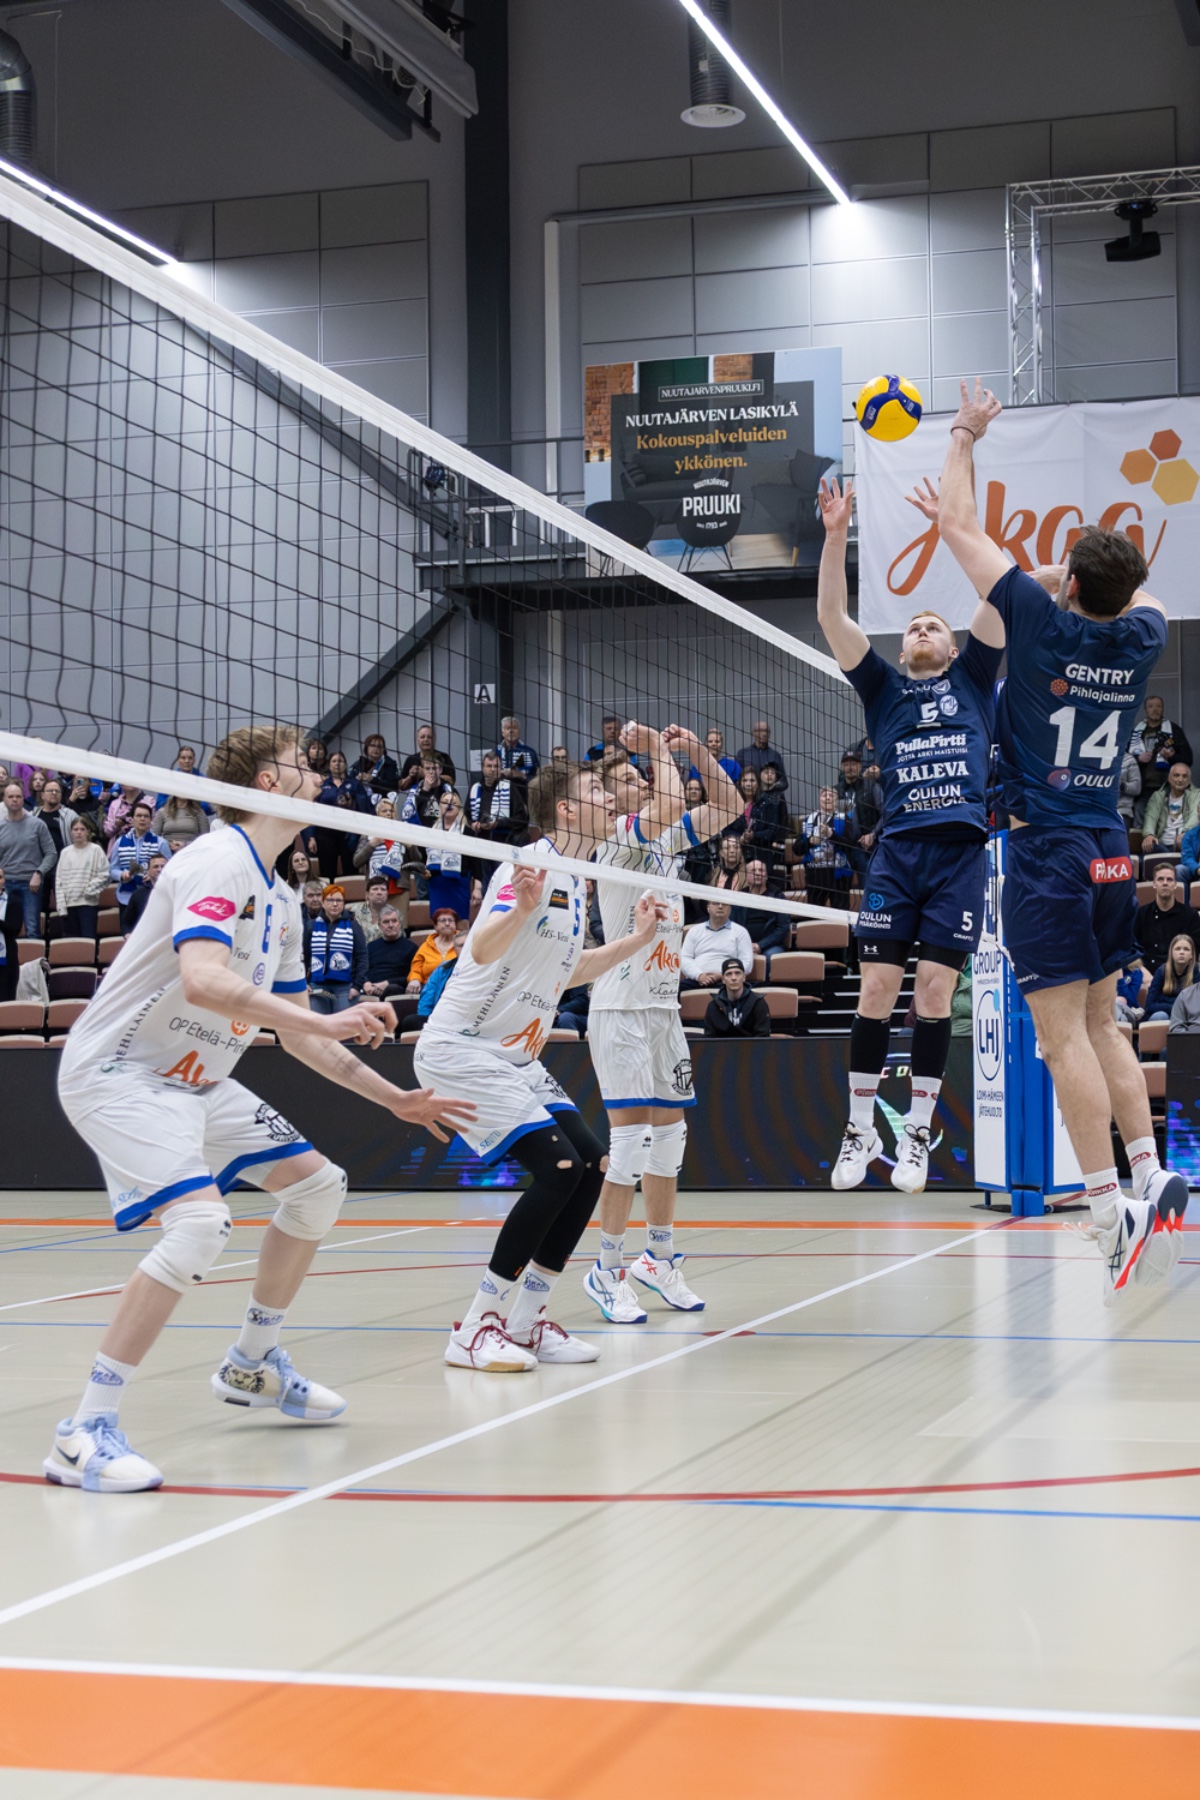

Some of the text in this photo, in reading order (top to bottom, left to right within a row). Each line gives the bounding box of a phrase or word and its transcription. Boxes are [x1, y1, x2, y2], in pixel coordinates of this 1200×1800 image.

[625, 401, 799, 428] NUUTAJÄRVEN LASIKYLÄ
[636, 426, 788, 450] Kokouspalveluiden
[675, 454, 748, 474] ykkönen.
[683, 494, 740, 517] PRUUKI
[1065, 663, 1134, 685] GENTRY
[477, 685, 491, 702] A
[1069, 685, 1136, 703] Pihlajalinna
[919, 702, 939, 723] 5
[896, 734, 966, 755] PullaPirtti
[1050, 706, 1122, 770] 14
[897, 761, 969, 783] KALEVA
[1074, 773, 1115, 788] OULU
[908, 785, 961, 801] OULUN
[860, 911, 891, 922] OULUN
[961, 911, 973, 931] 5
[973, 951, 1001, 975] GROUP
[169, 1017, 188, 1033] OP
[978, 1018, 999, 1063] LHJ
